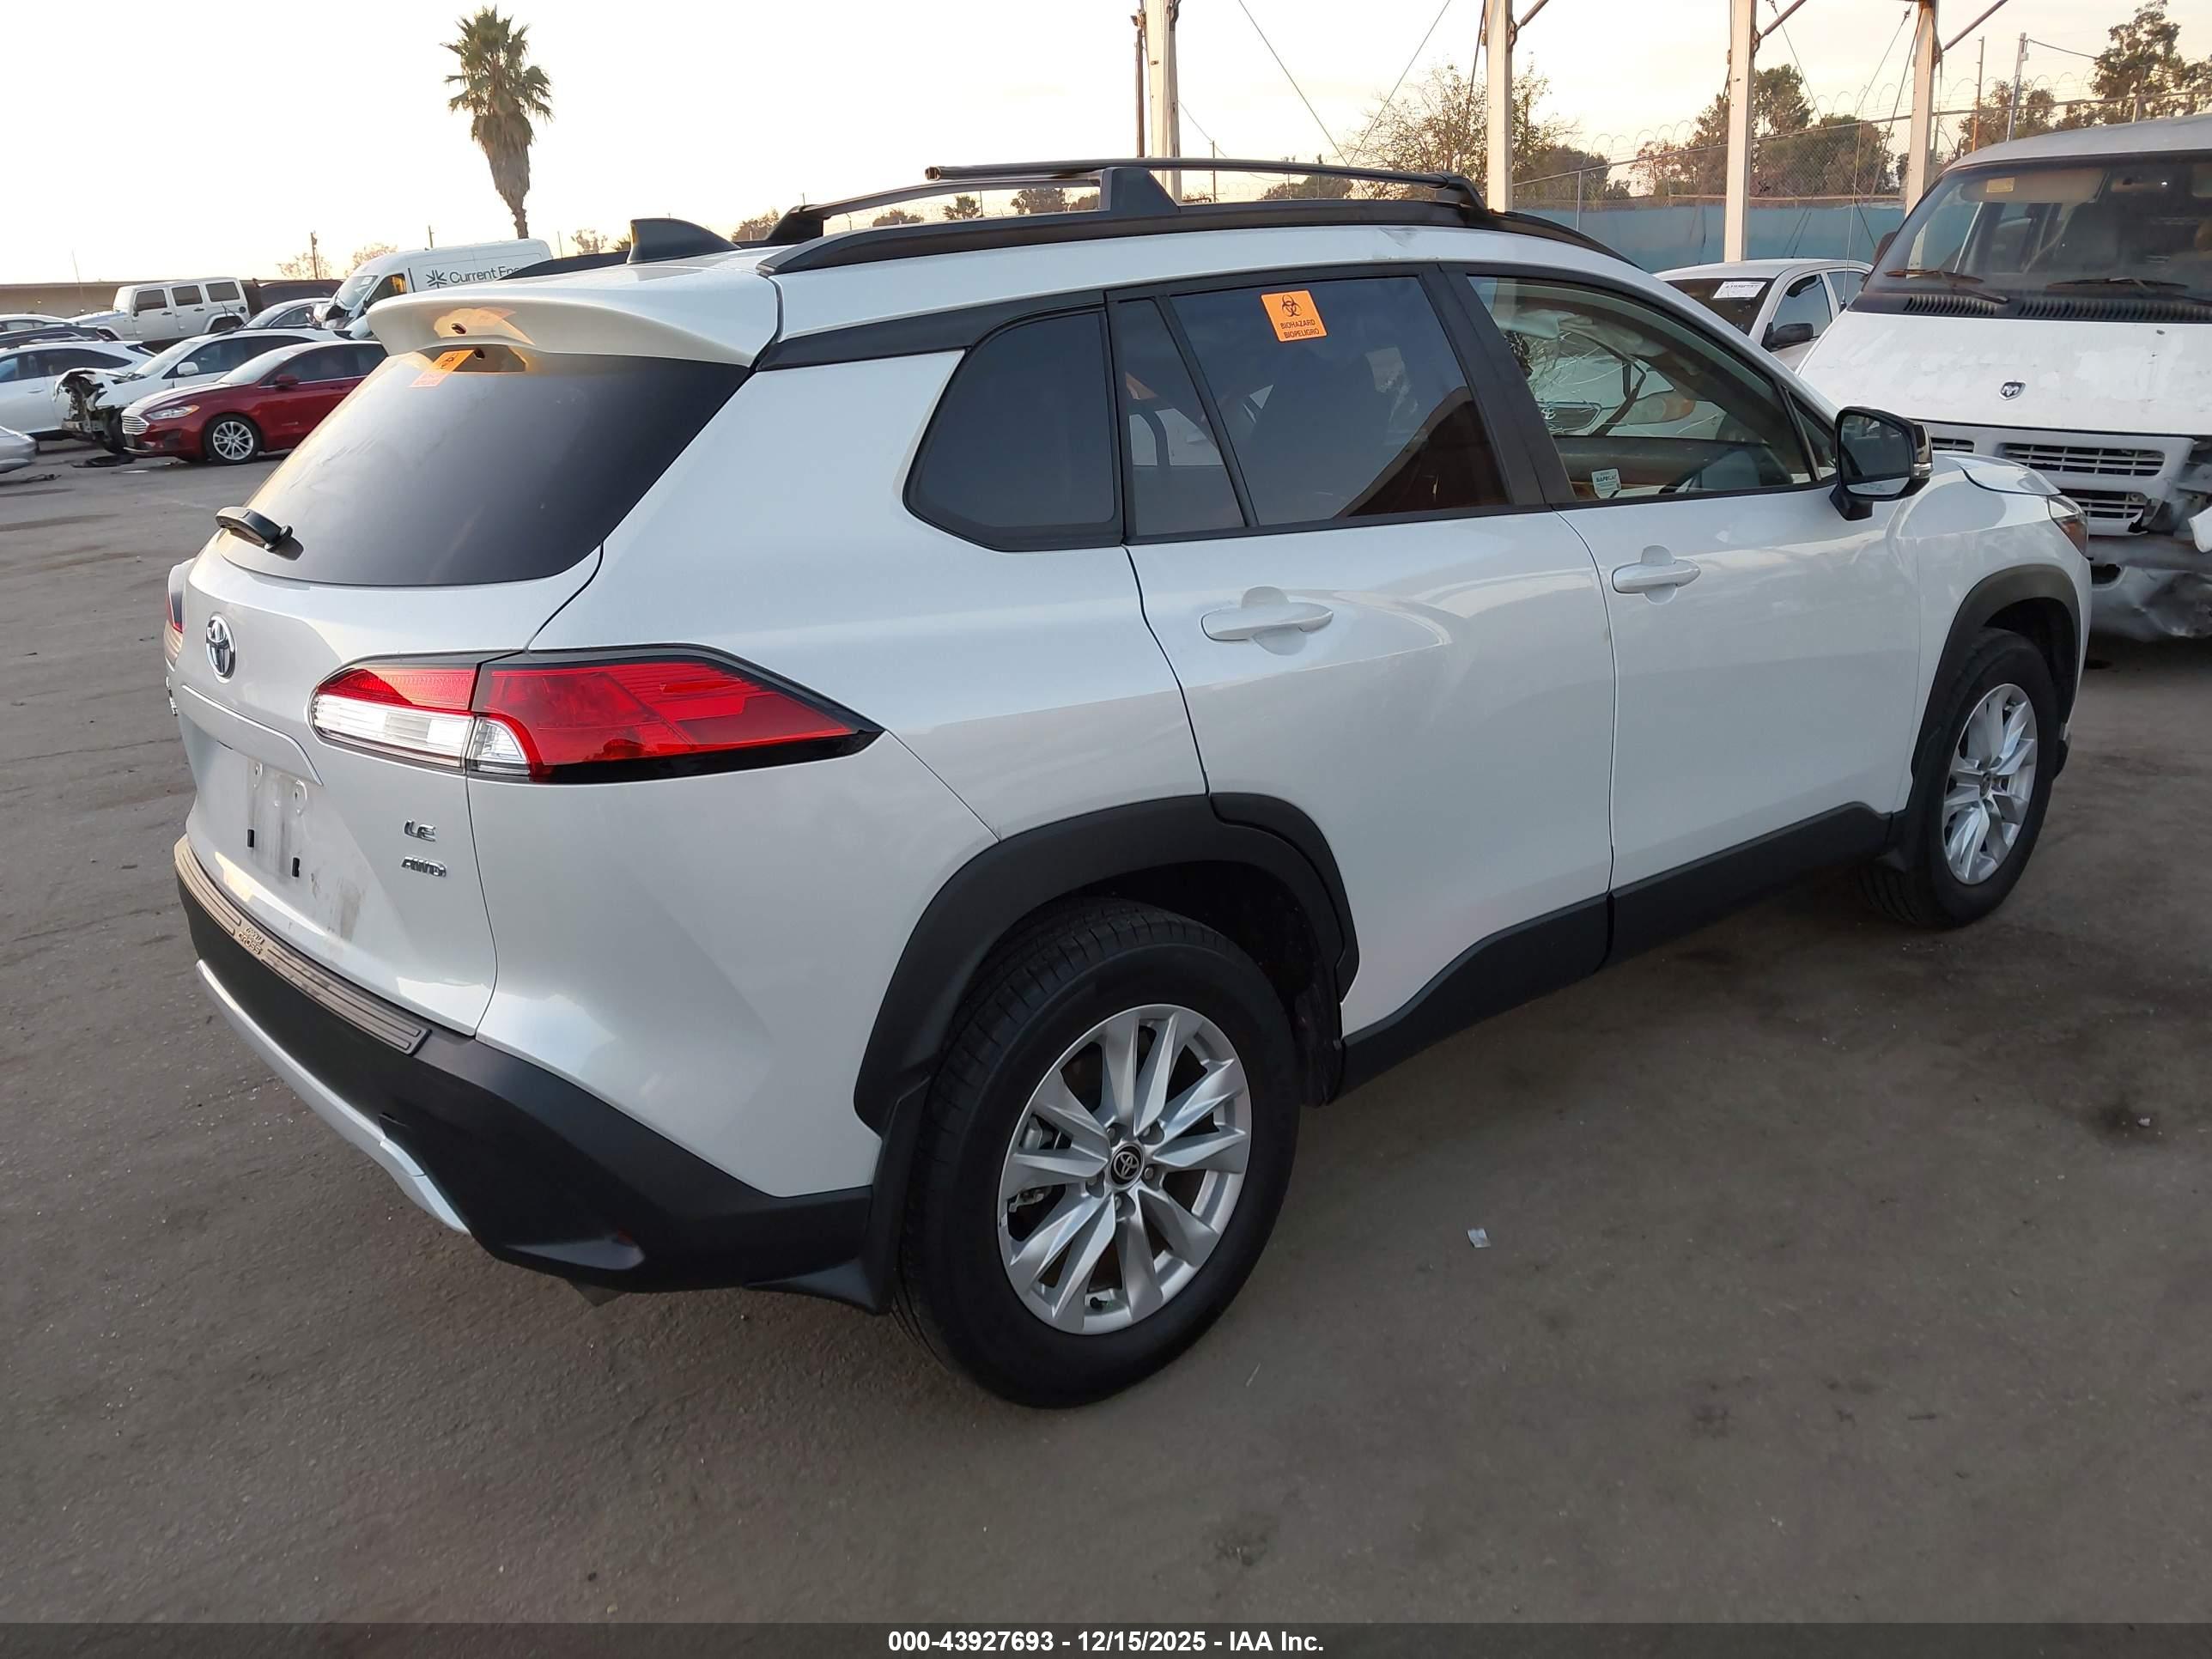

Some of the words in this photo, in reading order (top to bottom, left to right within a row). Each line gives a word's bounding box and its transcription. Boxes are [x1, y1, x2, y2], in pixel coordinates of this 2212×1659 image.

[449, 268, 497, 283] Current
[1280, 319, 1316, 329] BIOHAZARD
[1284, 328, 1319, 338] BIOPELIGRO
[404, 819, 436, 842] LE
[401, 856, 447, 877] AWD
[238, 932, 263, 955] CROSS
